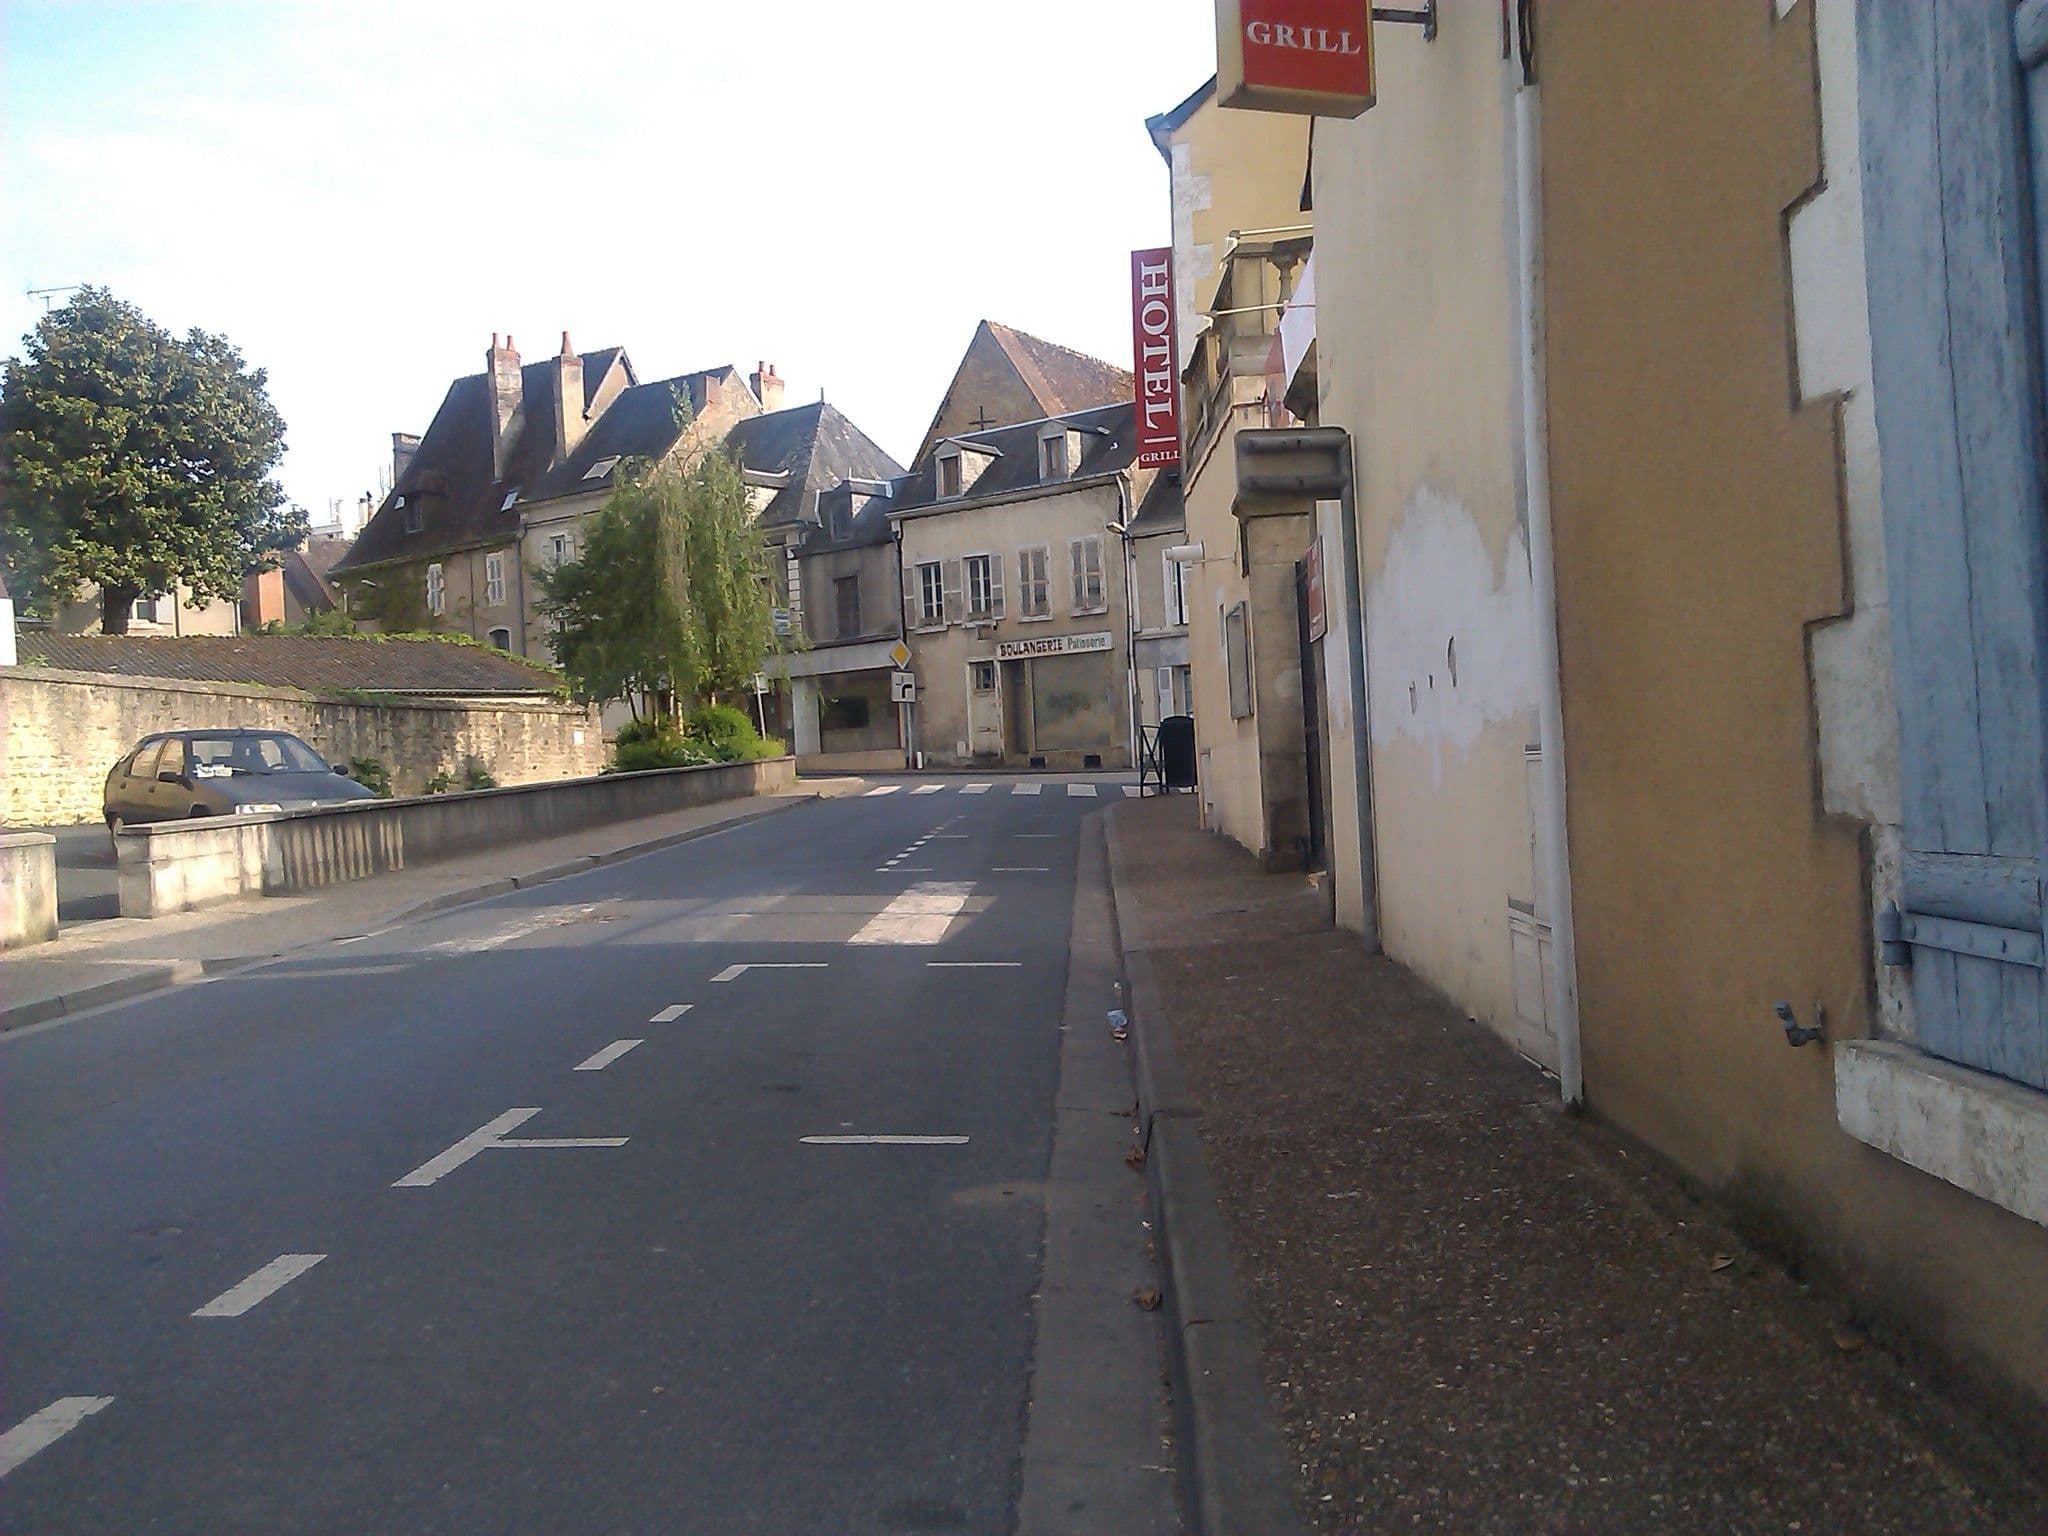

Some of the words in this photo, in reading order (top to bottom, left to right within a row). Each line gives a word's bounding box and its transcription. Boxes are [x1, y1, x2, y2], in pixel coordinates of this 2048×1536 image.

[1247, 20, 1361, 55] GRILL
[1141, 259, 1173, 429] HOTEL
[1140, 449, 1181, 463] GRILL
[1000, 639, 1064, 656] BOULANGERIE
